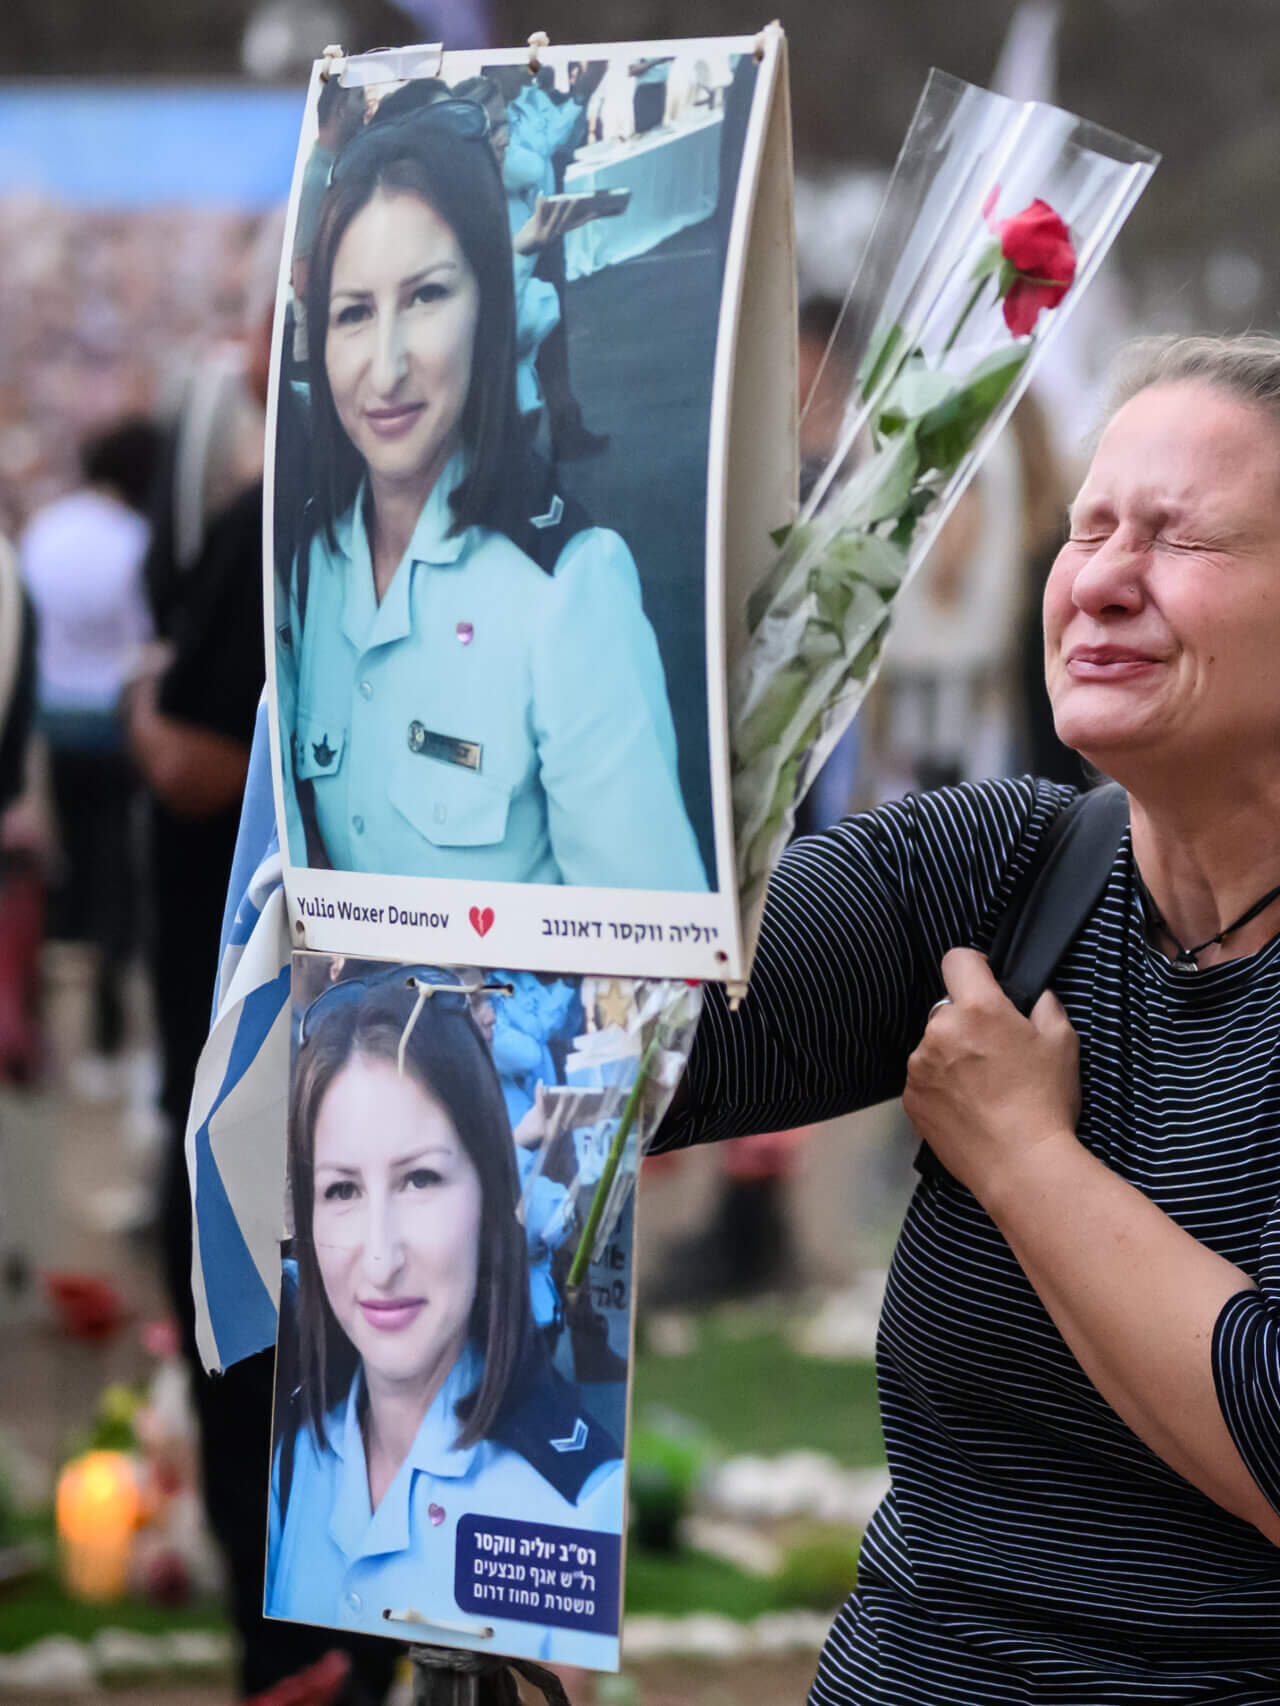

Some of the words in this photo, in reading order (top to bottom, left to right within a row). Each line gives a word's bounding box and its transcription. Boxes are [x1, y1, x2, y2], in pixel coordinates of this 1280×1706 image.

[297, 897, 335, 918] Yulia
[337, 901, 384, 923] Waxer
[388, 906, 449, 928] Daunov
[542, 918, 602, 938] דאונוב
[608, 922, 663, 943] ווקסר
[669, 923, 718, 944] יוליה
[474, 1532, 516, 1556] ווקסר
[520, 1537, 555, 1559] יוליה
[474, 1559, 525, 1581] מבצעים
[530, 1566, 556, 1587] אגף
[473, 1583, 504, 1601] דרום
[509, 1588, 540, 1607] מחוז
[544, 1593, 595, 1616] משטרת
